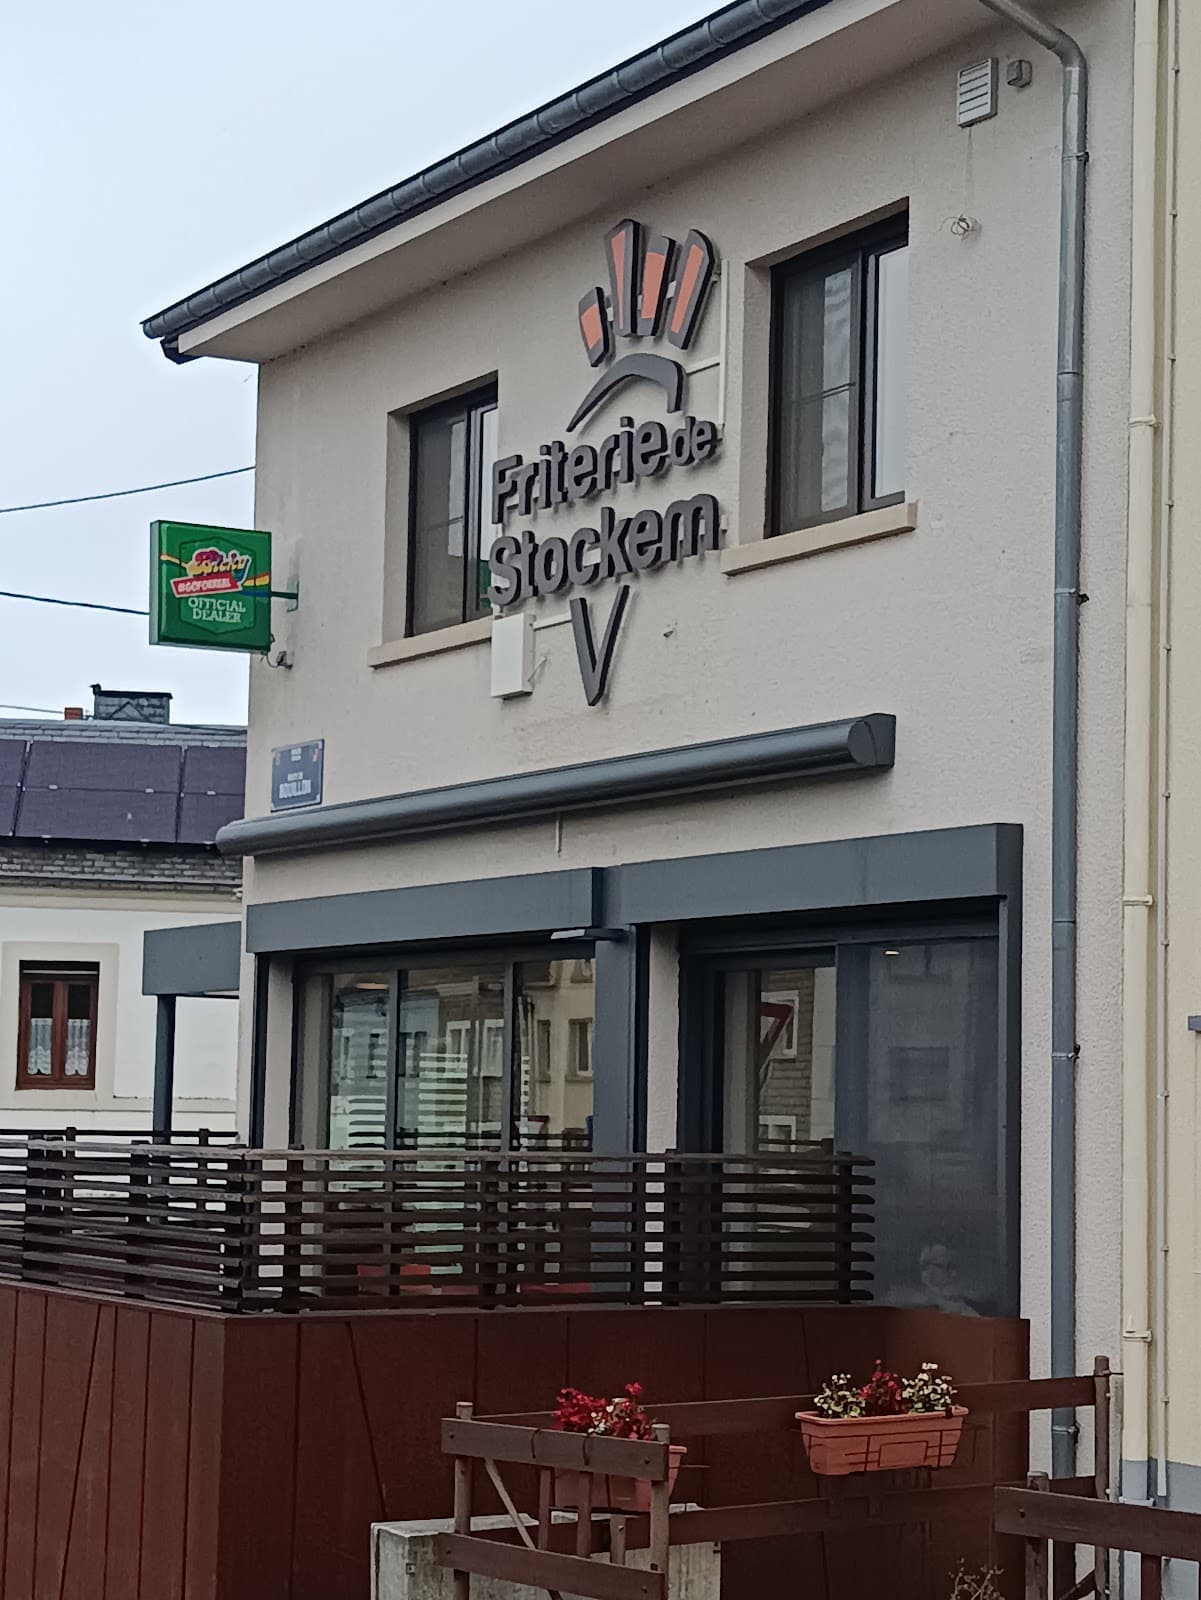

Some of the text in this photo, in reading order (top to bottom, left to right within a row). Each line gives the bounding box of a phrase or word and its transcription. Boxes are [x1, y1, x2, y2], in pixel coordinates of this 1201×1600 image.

[492, 416, 718, 524] Friterie de
[488, 494, 719, 605] Stockem
[188, 597, 246, 612] OFFICIAL
[193, 608, 241, 622] DEALER
